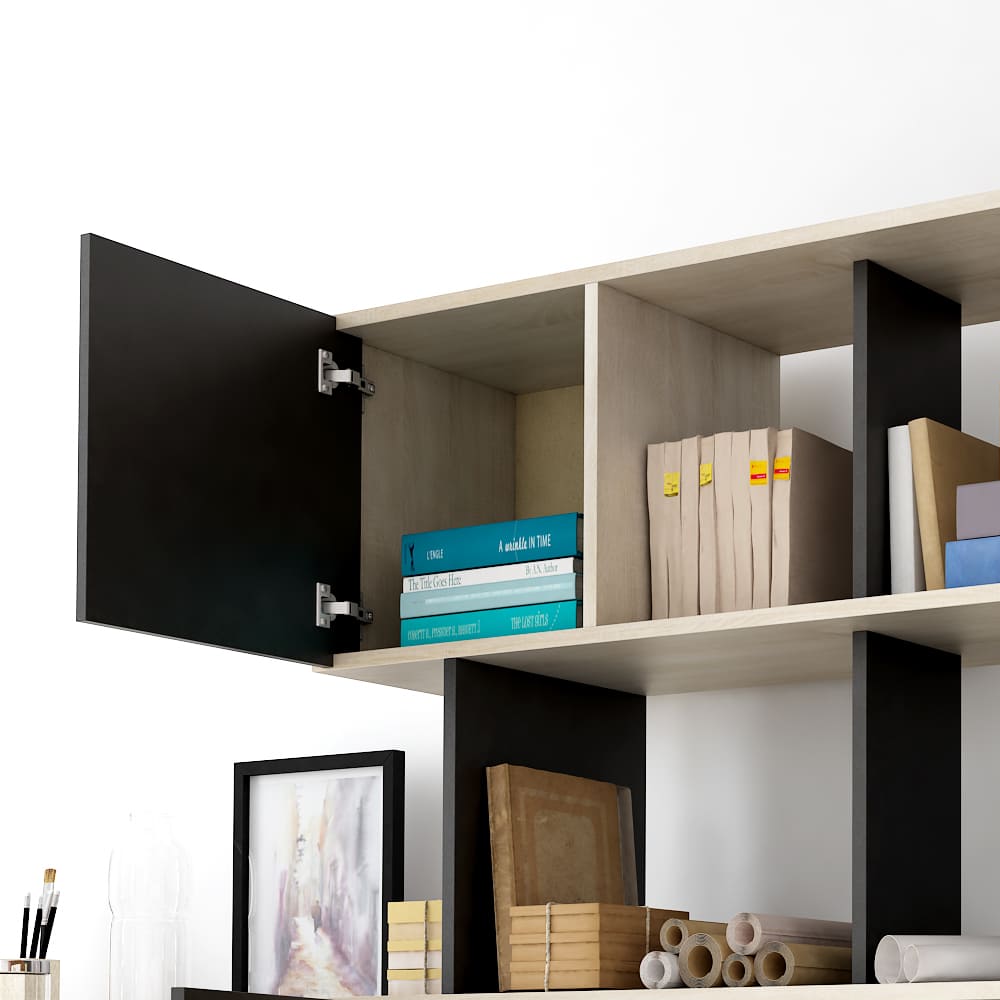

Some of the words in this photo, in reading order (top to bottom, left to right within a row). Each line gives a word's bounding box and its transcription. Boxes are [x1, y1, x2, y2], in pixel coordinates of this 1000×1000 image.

[498, 539, 504, 553] A
[528, 536, 536, 549] IN
[536, 533, 552, 548] TIME
